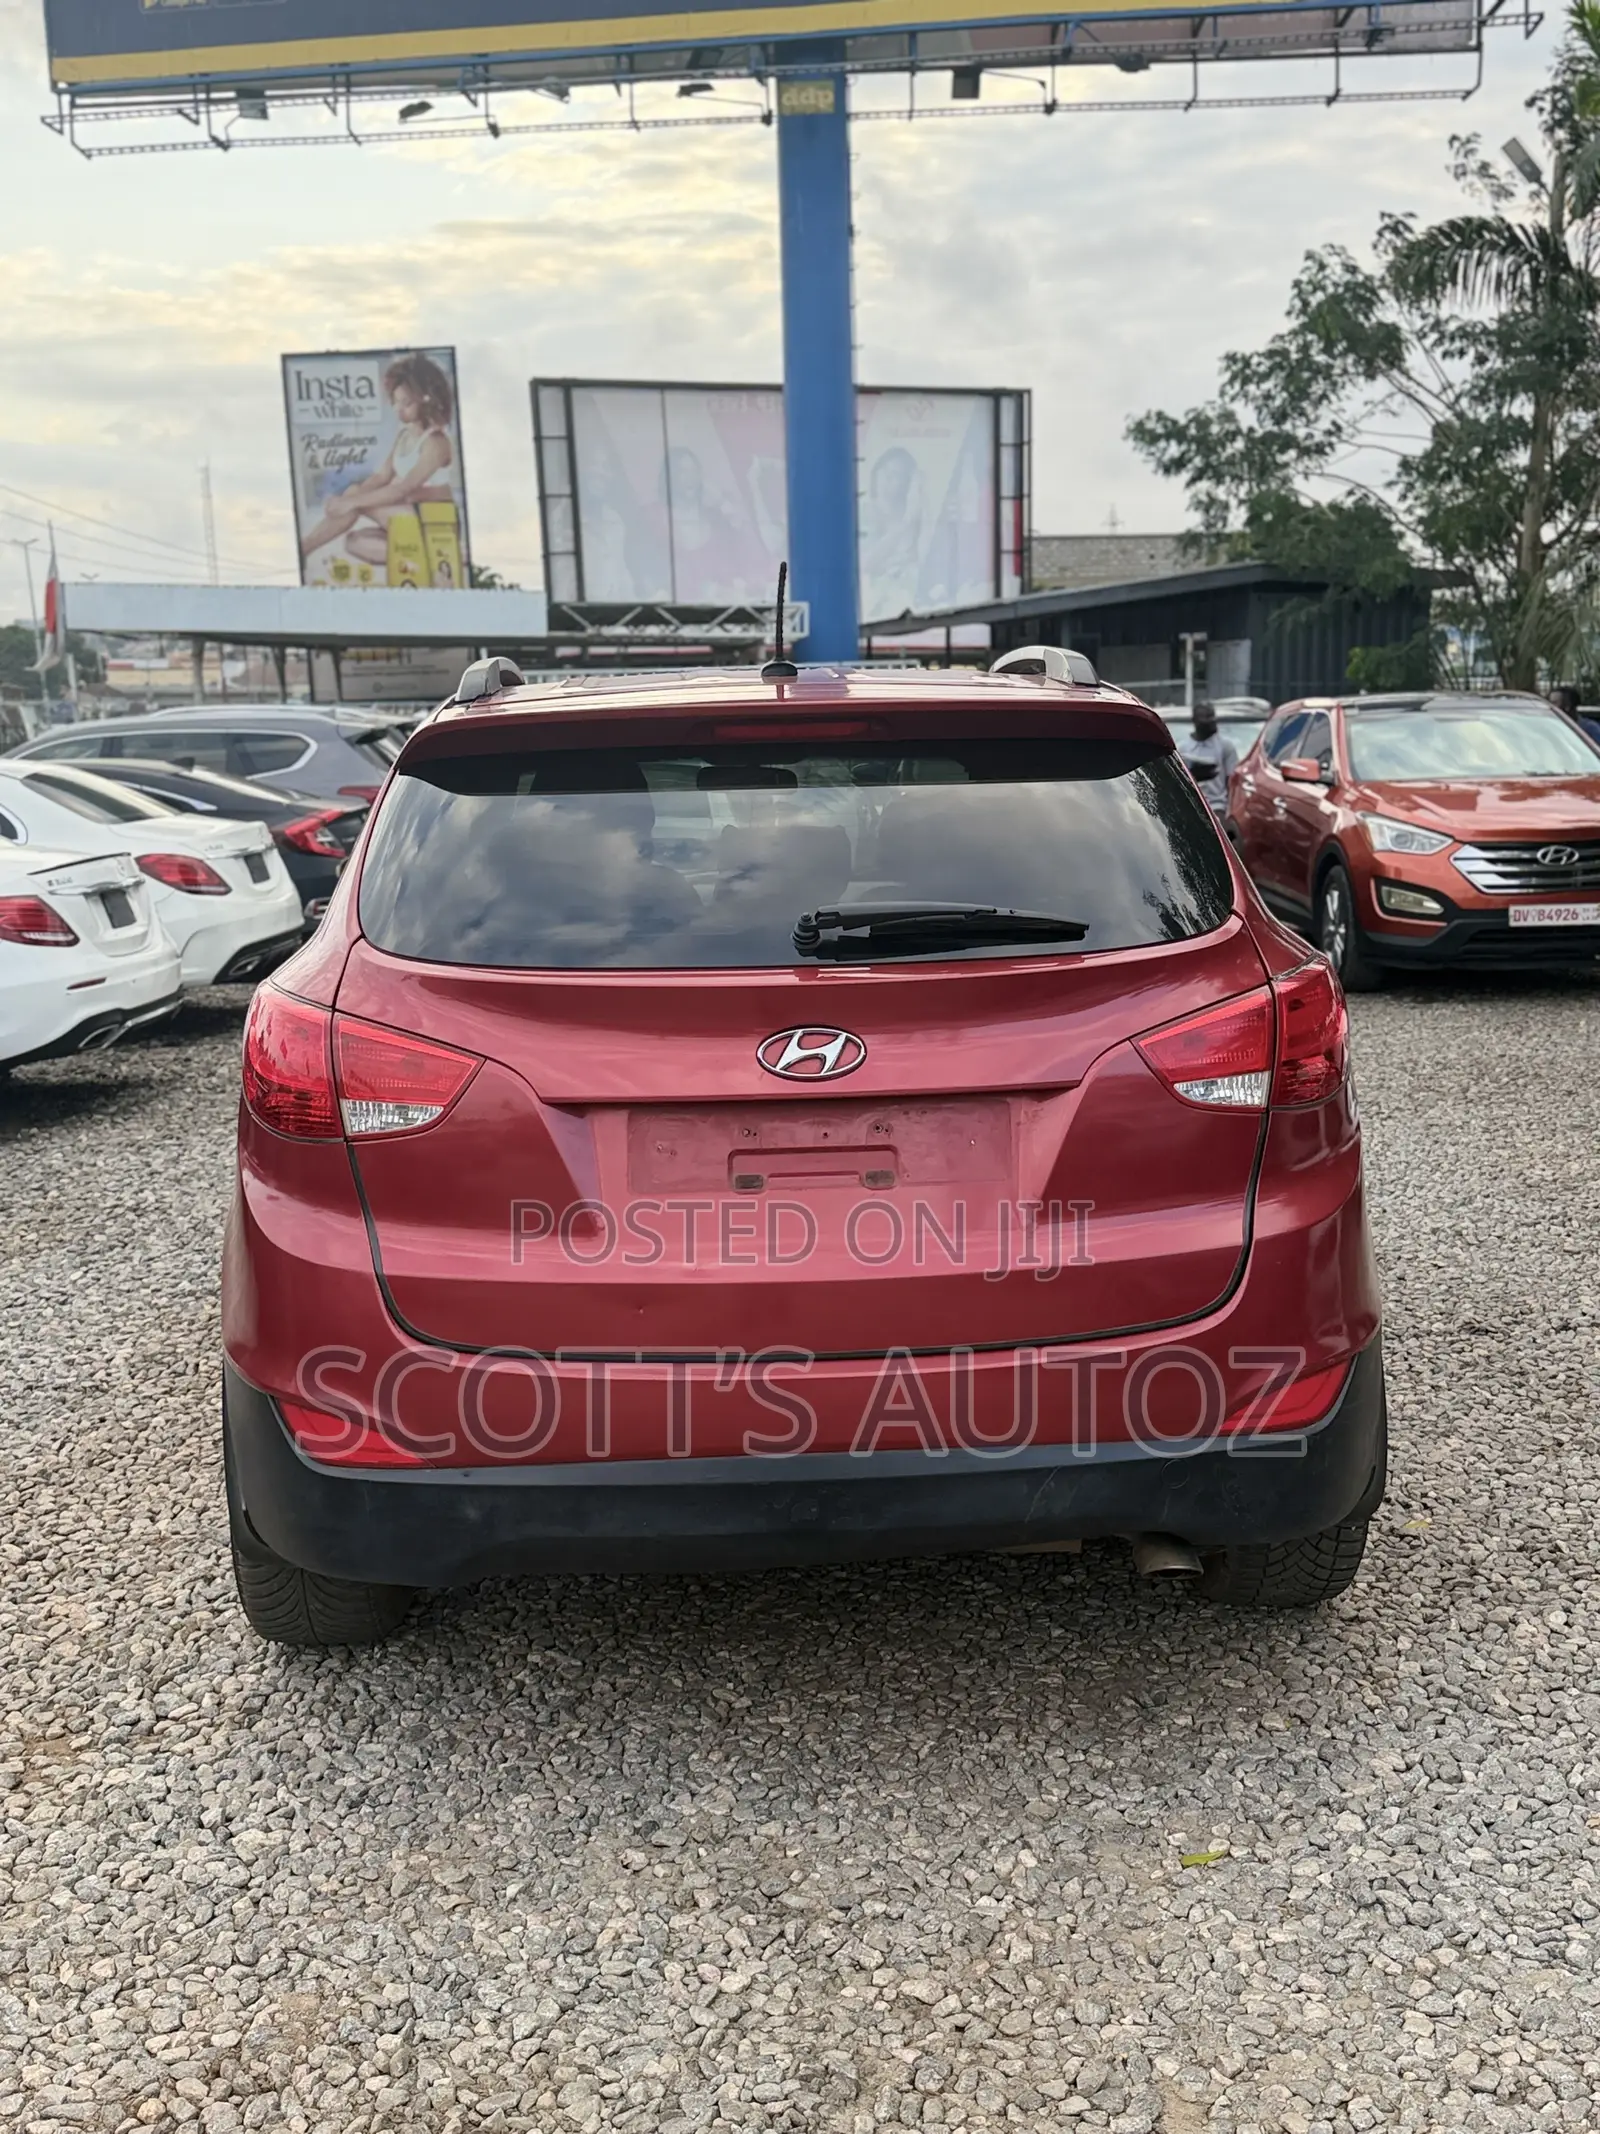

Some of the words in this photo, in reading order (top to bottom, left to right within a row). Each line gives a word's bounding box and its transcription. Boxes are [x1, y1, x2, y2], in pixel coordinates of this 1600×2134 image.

[294, 370, 376, 401] Insta
[301, 432, 378, 453] Radiance
[323, 448, 368, 474] light
[1513, 909, 1530, 922] DV
[1537, 908, 1579, 921] B4926
